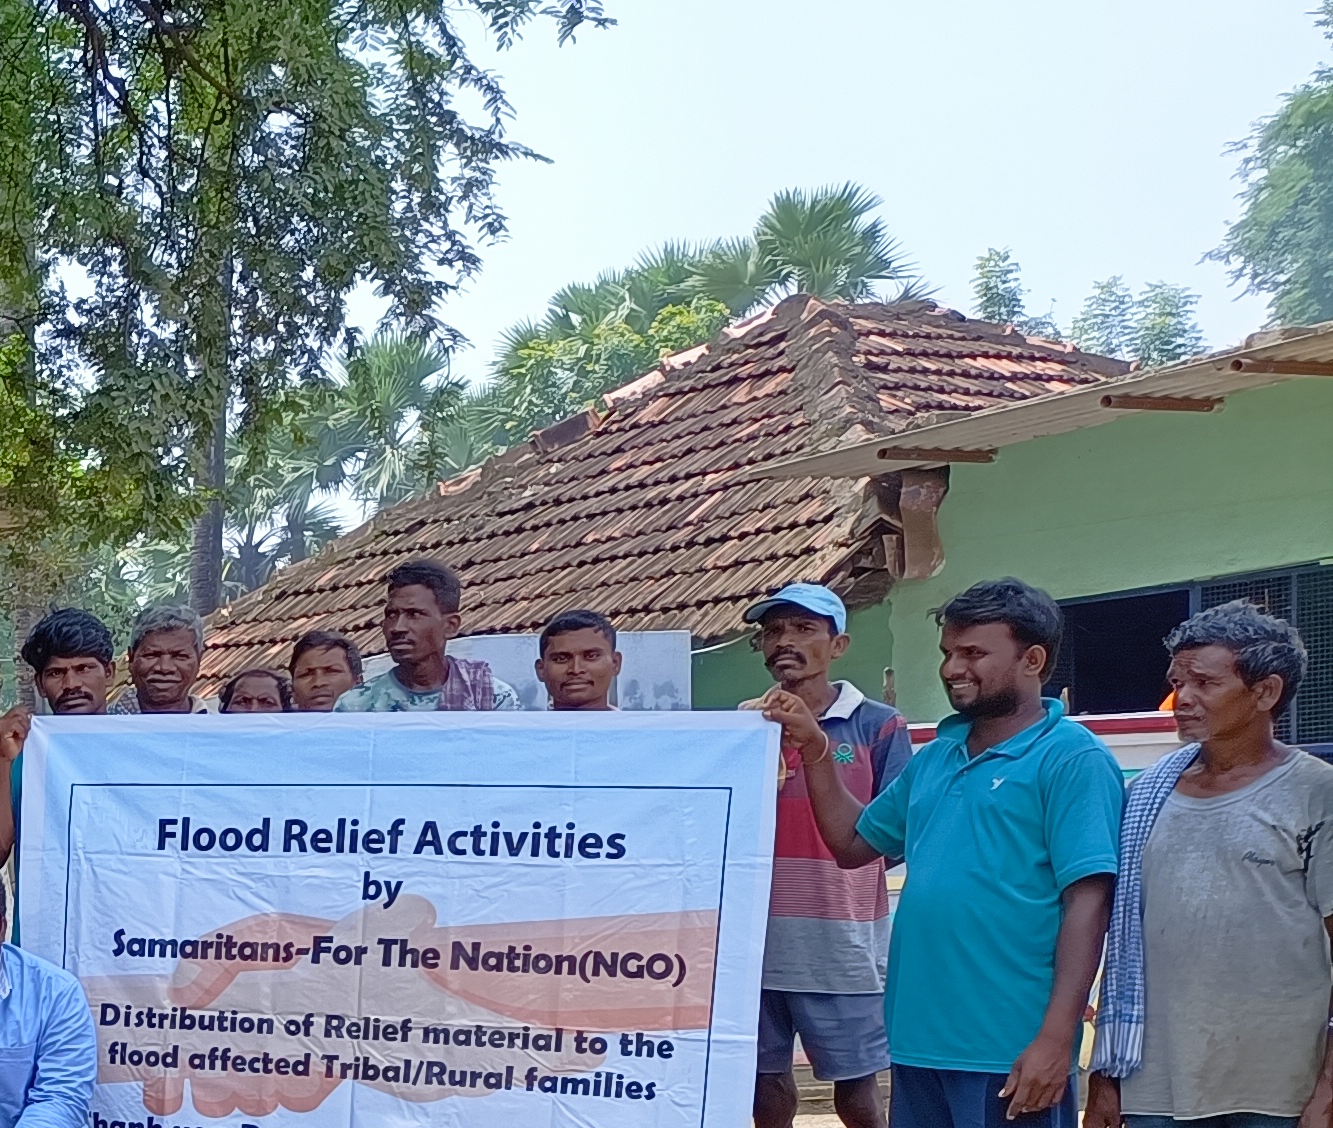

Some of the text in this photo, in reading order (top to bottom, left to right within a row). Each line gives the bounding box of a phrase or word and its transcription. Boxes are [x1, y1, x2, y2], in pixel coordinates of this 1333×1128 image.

[157, 818, 627, 860] Flood Relief Activities
[362, 871, 403, 908] by
[112, 930, 687, 988] Samaritans-For The Nation(NGO)
[99, 1003, 675, 1061] Distribution of Relief material to the
[108, 1041, 657, 1102] flood affected Tribal/Rural families
